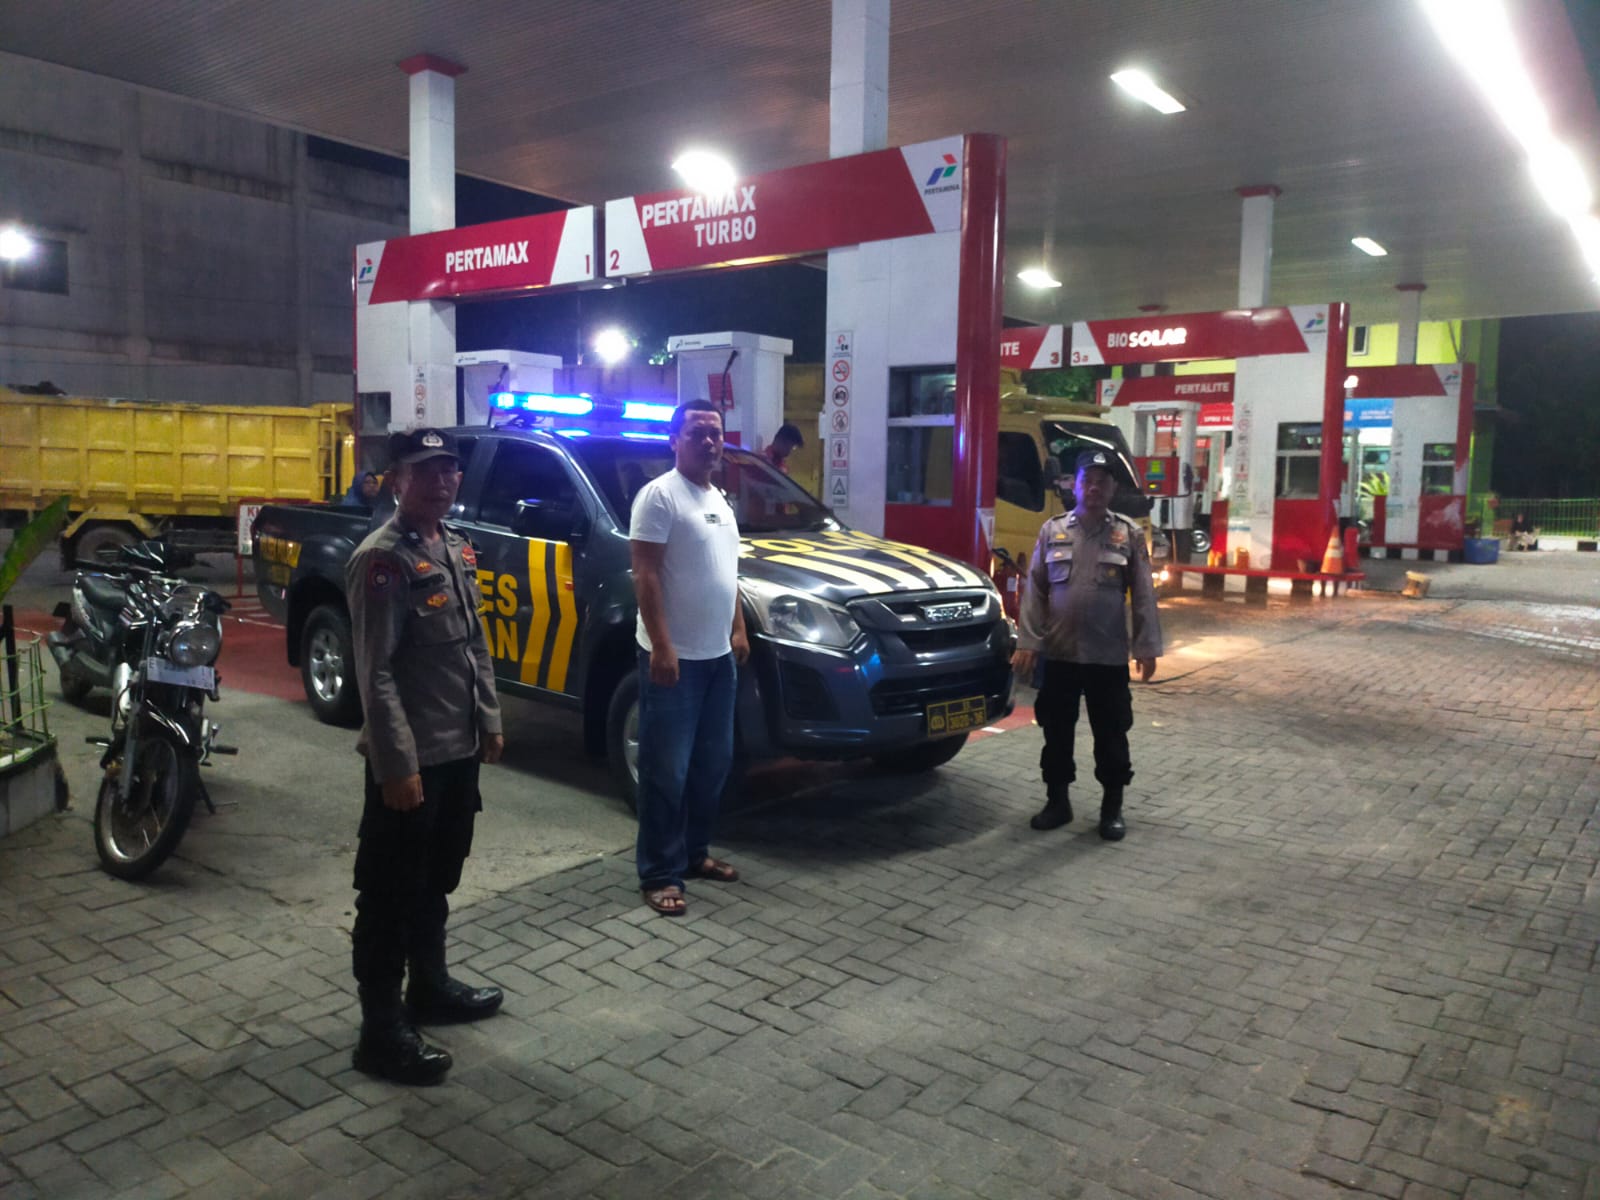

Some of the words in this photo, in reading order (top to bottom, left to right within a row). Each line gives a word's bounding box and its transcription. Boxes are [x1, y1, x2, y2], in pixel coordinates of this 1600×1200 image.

[642, 185, 756, 229] PERTAMAX
[694, 215, 756, 248] TURBO
[446, 240, 529, 273] PERTAMAX
[585, 254, 590, 275] 1
[610, 249, 620, 270] 2
[1050, 352, 1060, 365] 3
[1174, 382, 1230, 394] PERTALITE
